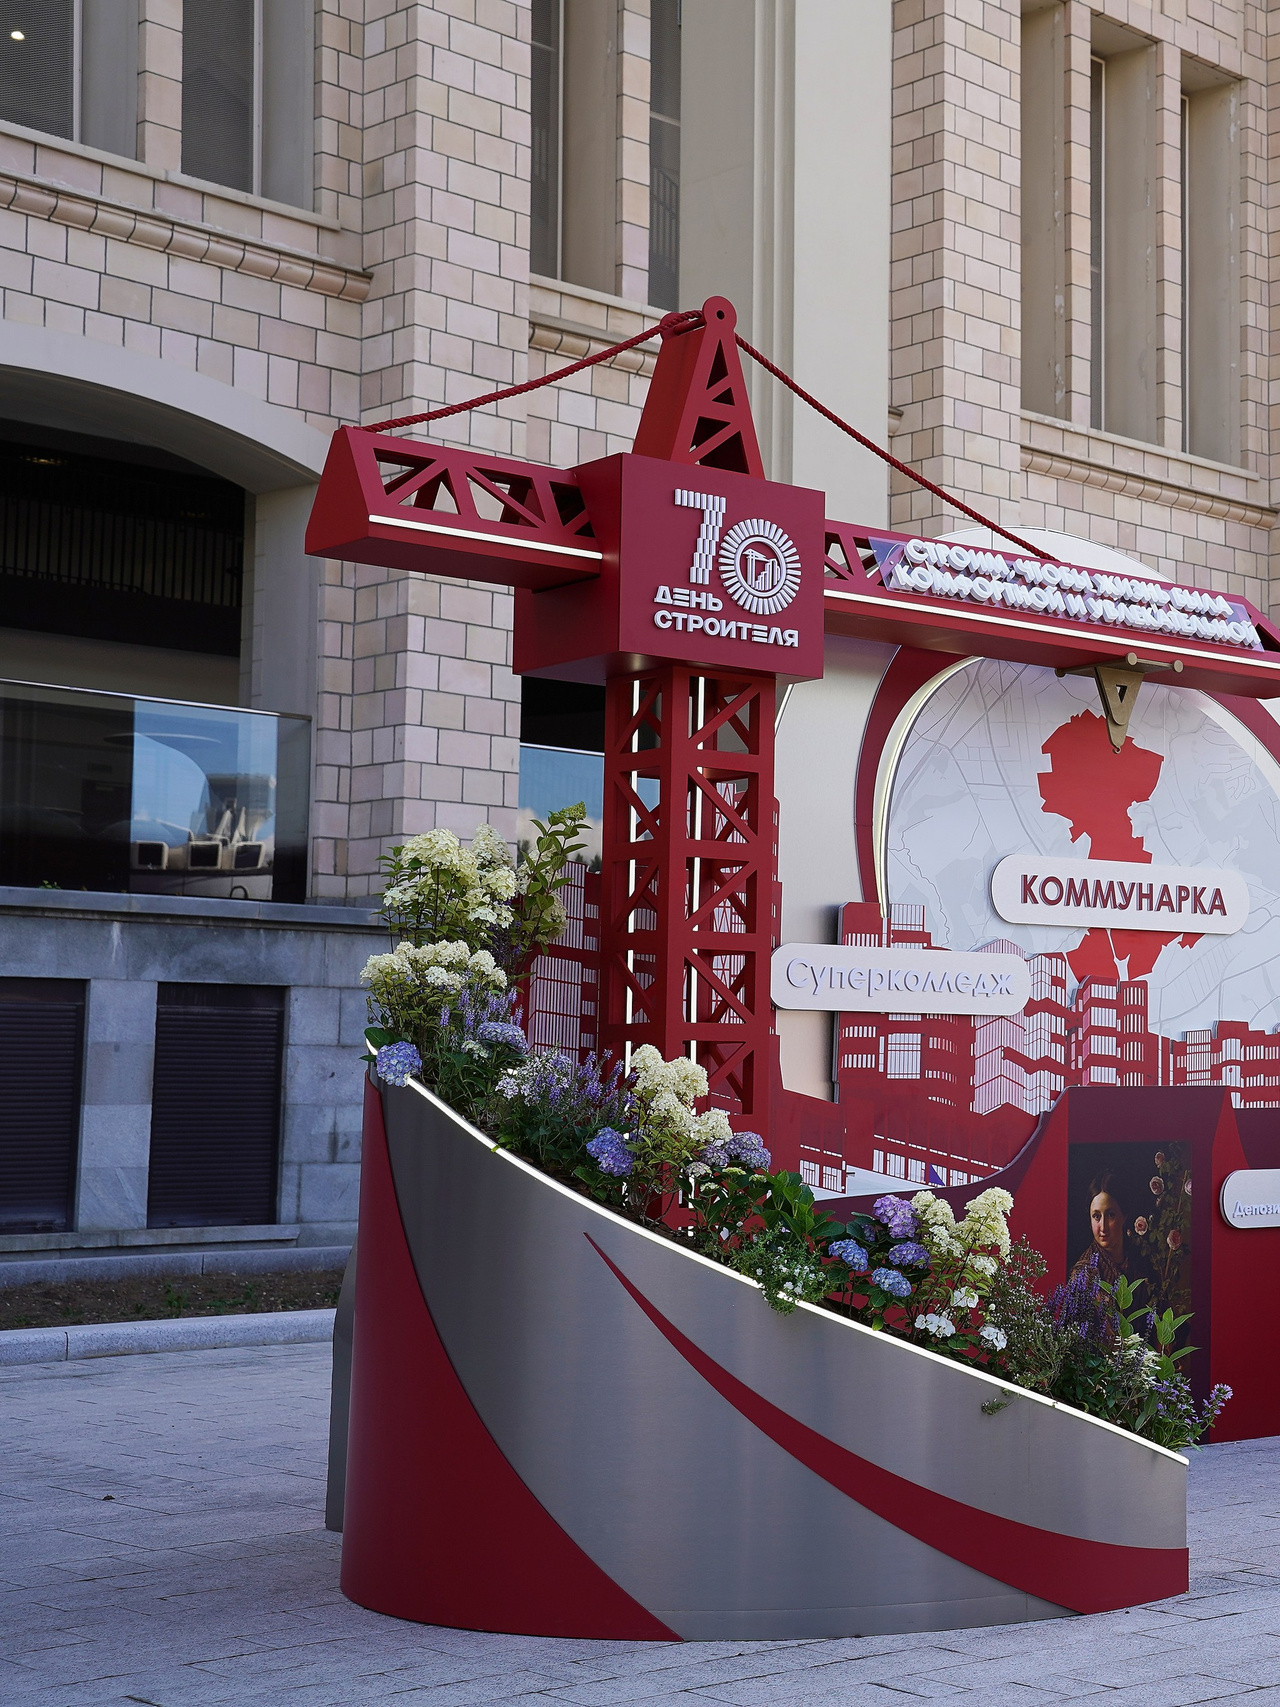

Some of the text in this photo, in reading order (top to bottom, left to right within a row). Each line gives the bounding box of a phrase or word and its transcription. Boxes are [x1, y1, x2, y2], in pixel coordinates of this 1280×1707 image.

[654, 585, 723, 612] ДЕНЬ
[654, 610, 799, 648] СТРОИТЕЛЯ
[1020, 874, 1228, 916] КОММУНАРКА
[786, 957, 1016, 998] Суперколледж
